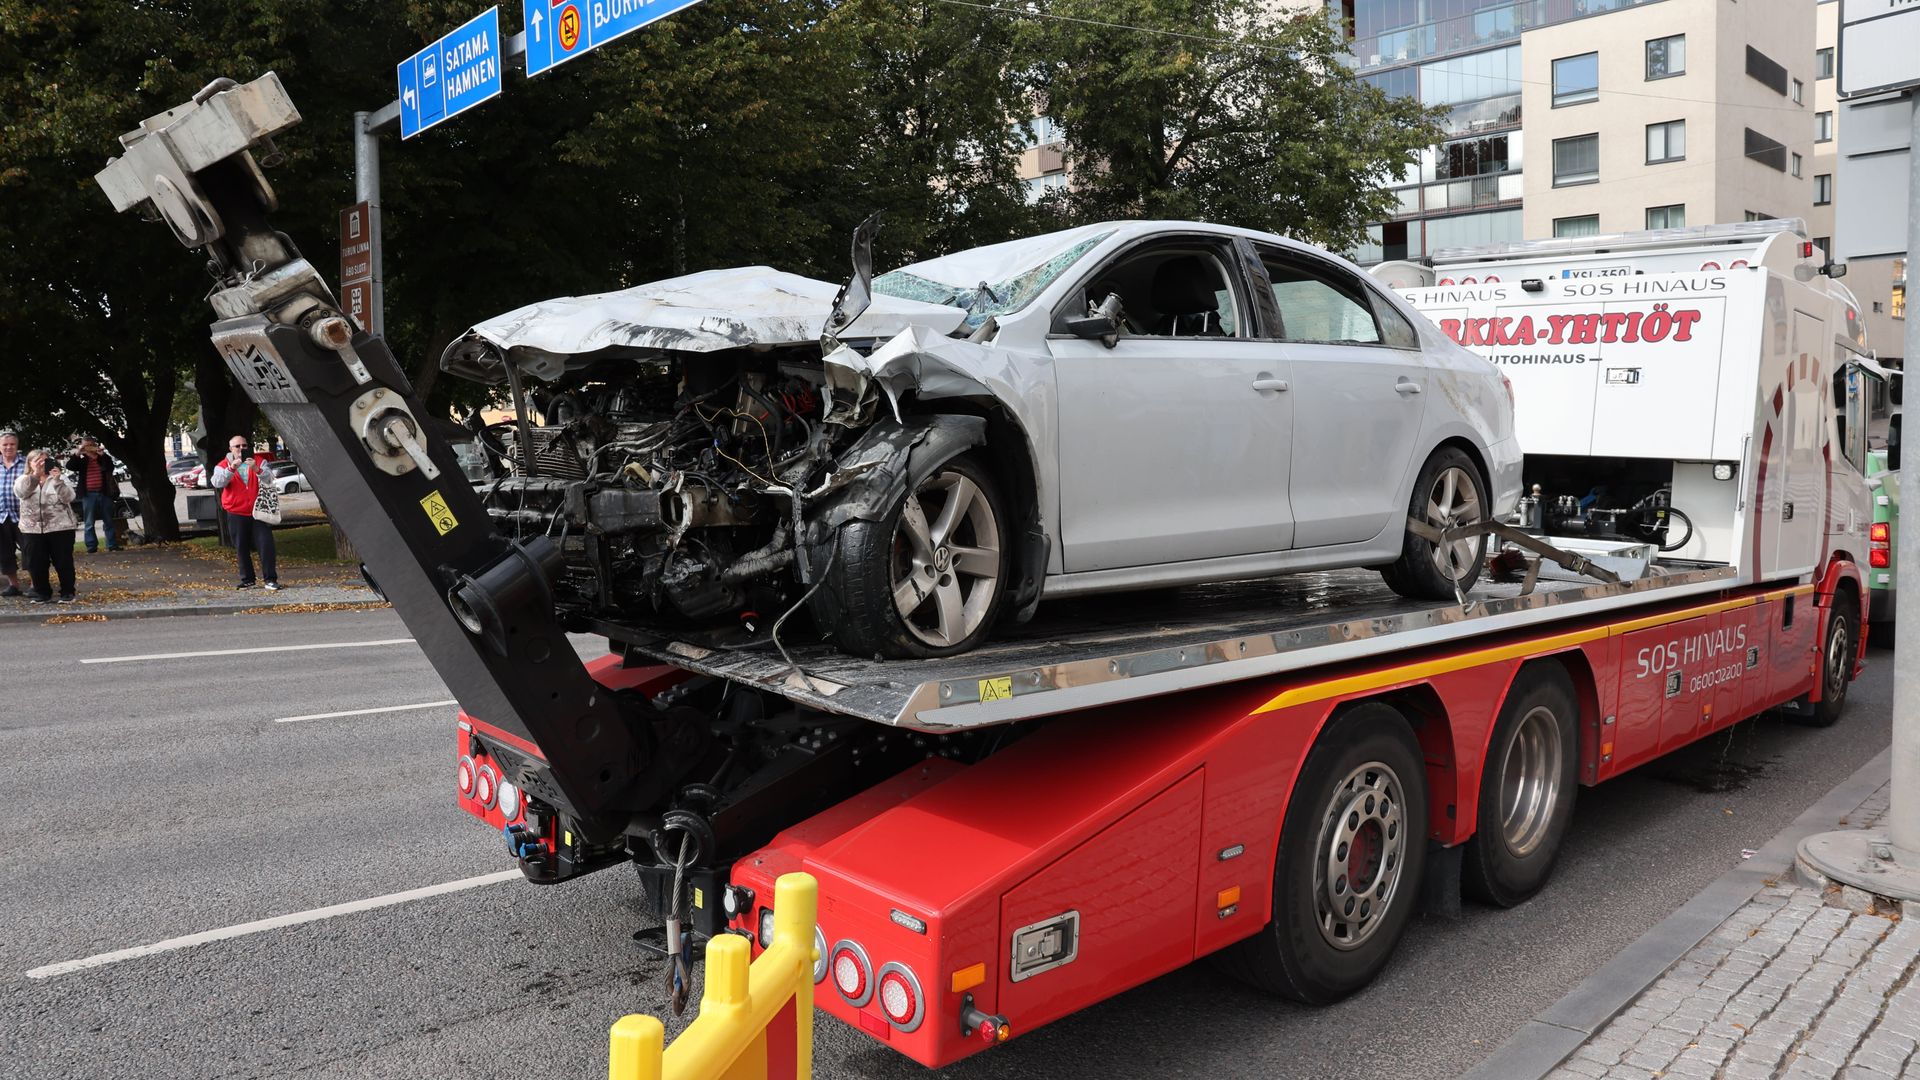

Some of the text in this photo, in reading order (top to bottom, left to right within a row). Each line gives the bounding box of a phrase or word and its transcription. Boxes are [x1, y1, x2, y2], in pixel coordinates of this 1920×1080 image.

[446, 30, 489, 72] SATAMA
[447, 56, 495, 100] HAMNEN
[1424, 288, 1507, 304] HINAUS
[1563, 277, 1726, 297] SOS HINAUS
[1439, 303, 1701, 347] RKKA-YHTIÖT
[1483, 354, 1586, 365] UTOHINAUS
[1636, 640, 1678, 679] SOS
